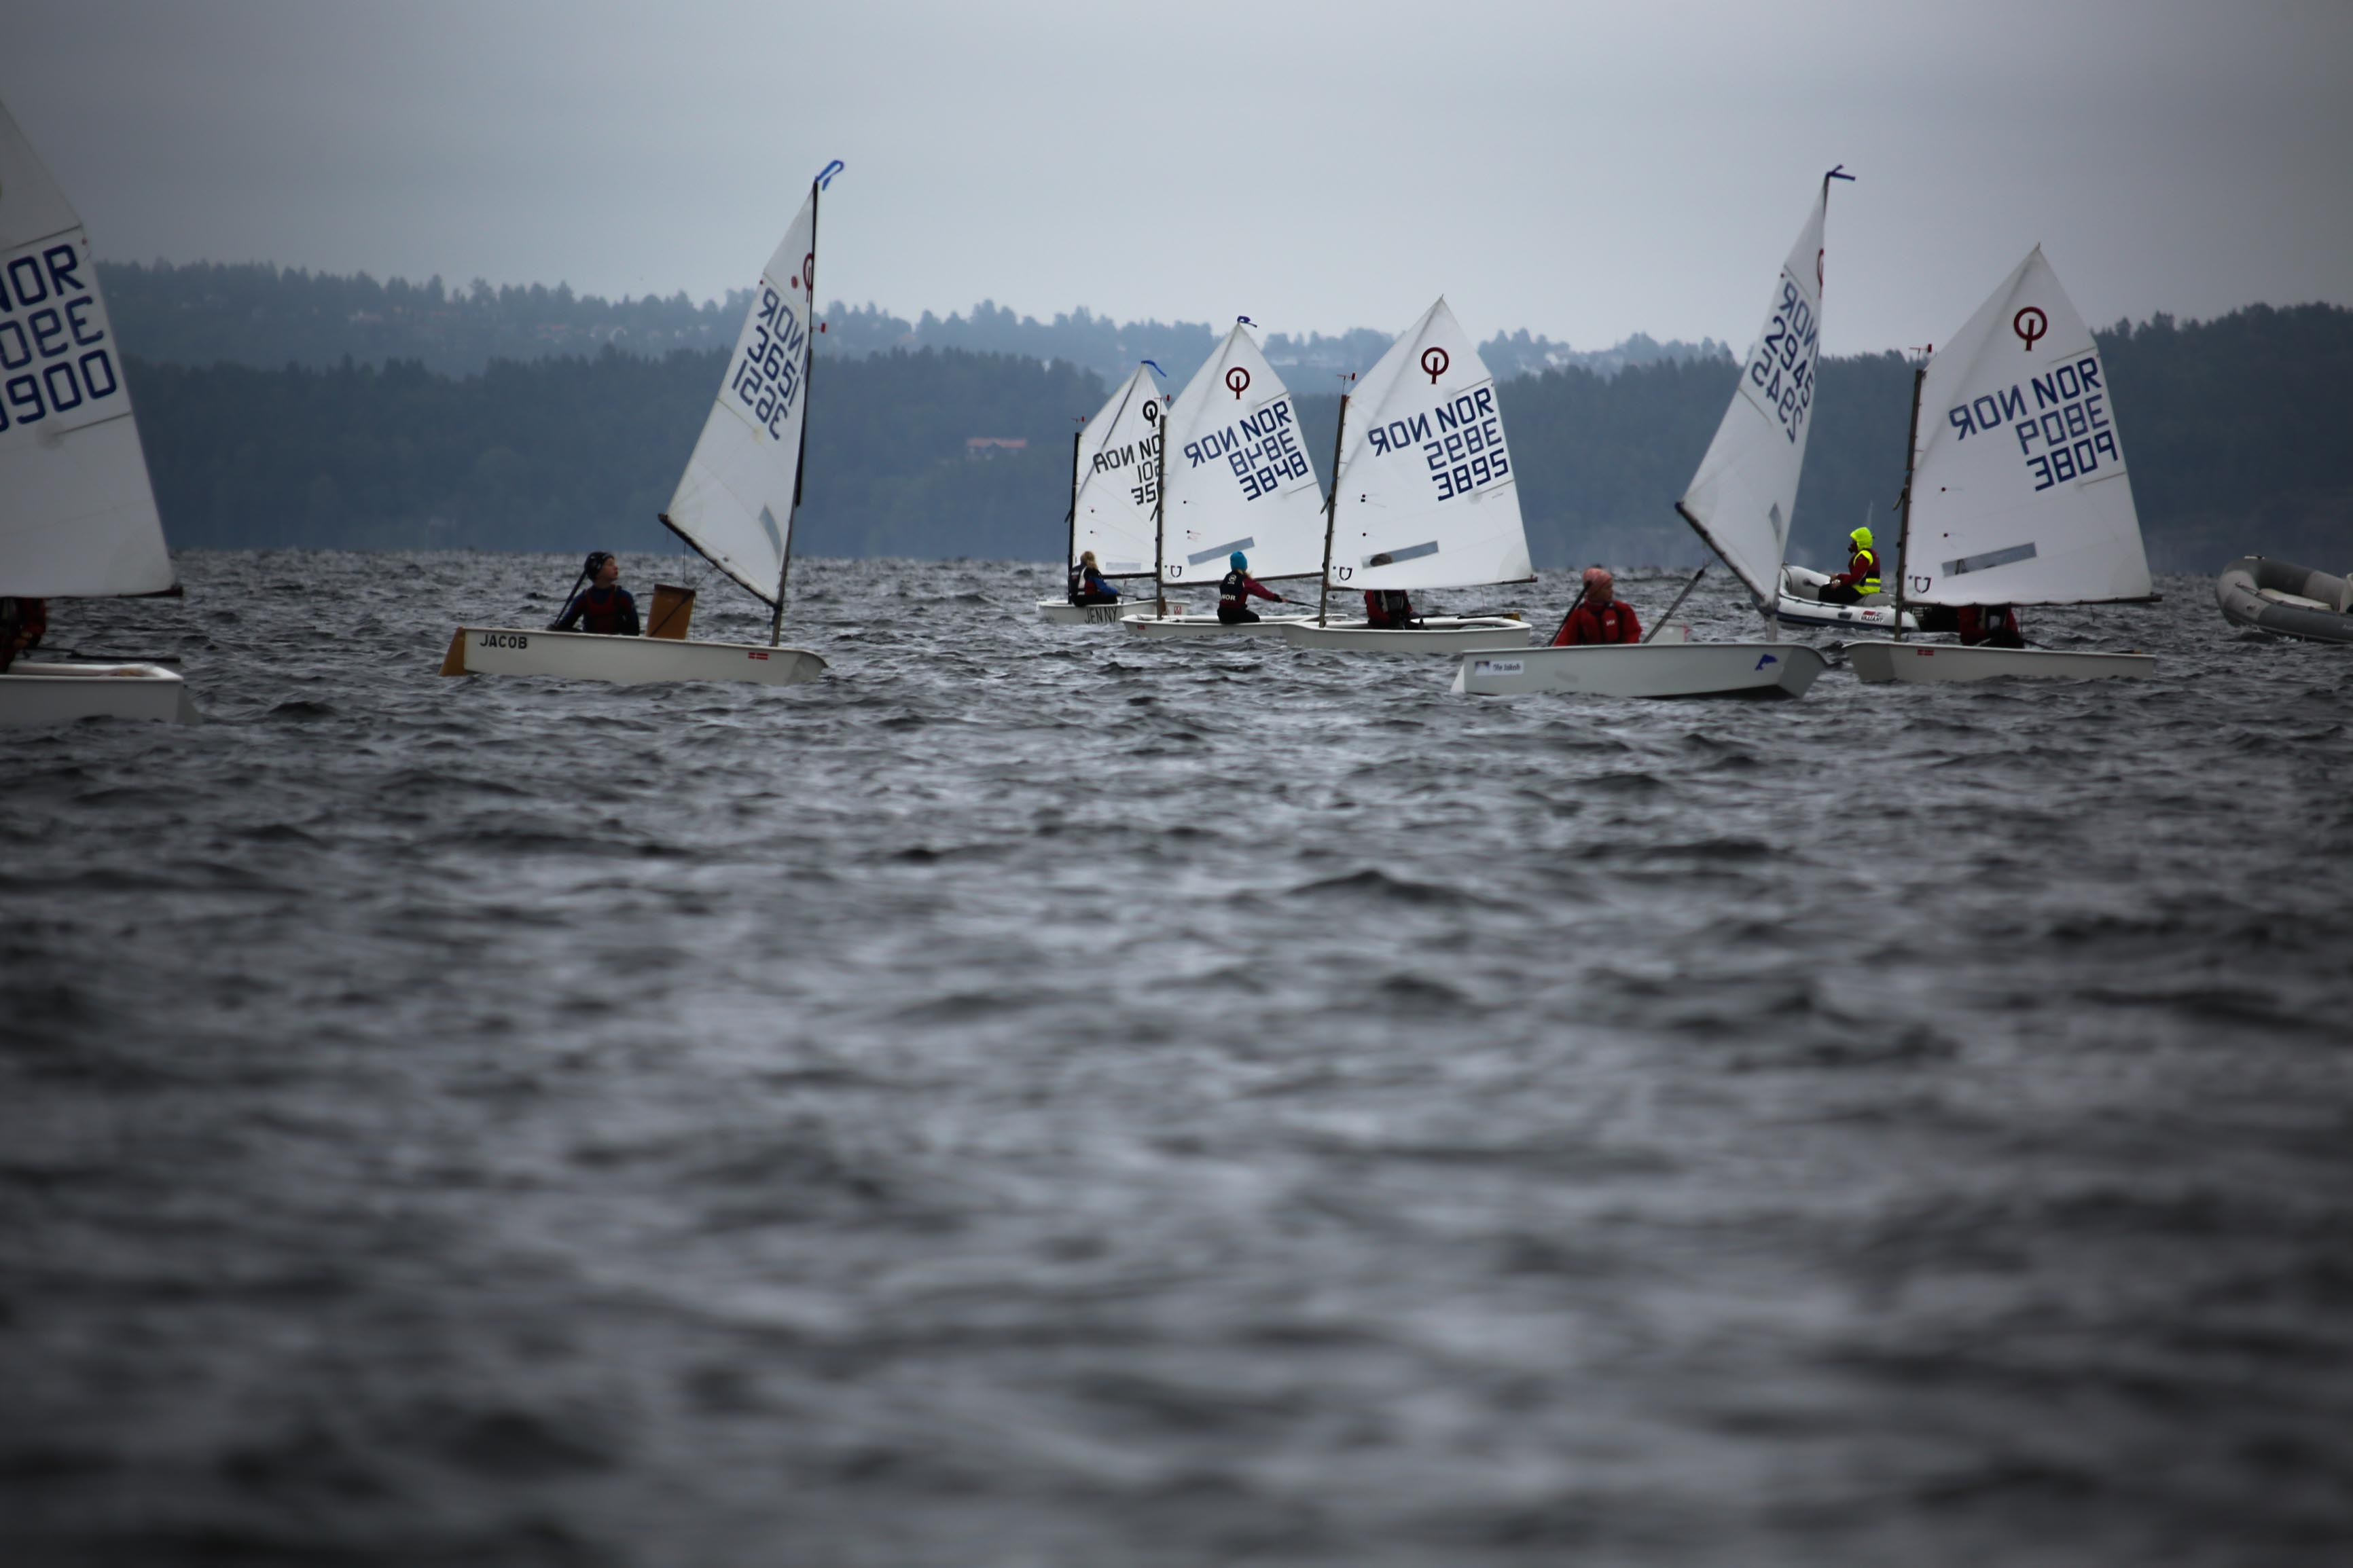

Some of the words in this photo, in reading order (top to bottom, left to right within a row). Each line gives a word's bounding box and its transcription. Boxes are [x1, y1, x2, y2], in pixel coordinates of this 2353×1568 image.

[747, 325, 800, 407] 3651
[1765, 315, 1813, 409] 2945
[2031, 357, 2102, 409] NOR
[0, 349, 117, 432] 900
[1435, 387, 1494, 433] NOR
[1138, 434, 1160, 460] NO
[1239, 400, 1292, 442] NOR
[1239, 450, 1309, 502] 3848
[1431, 447, 1509, 501] 3895
[2026, 429, 2119, 492] 3809
[1130, 481, 1157, 506] 35
[1084, 606, 1118, 624] JENNY
[480, 634, 528, 649] JACOB
